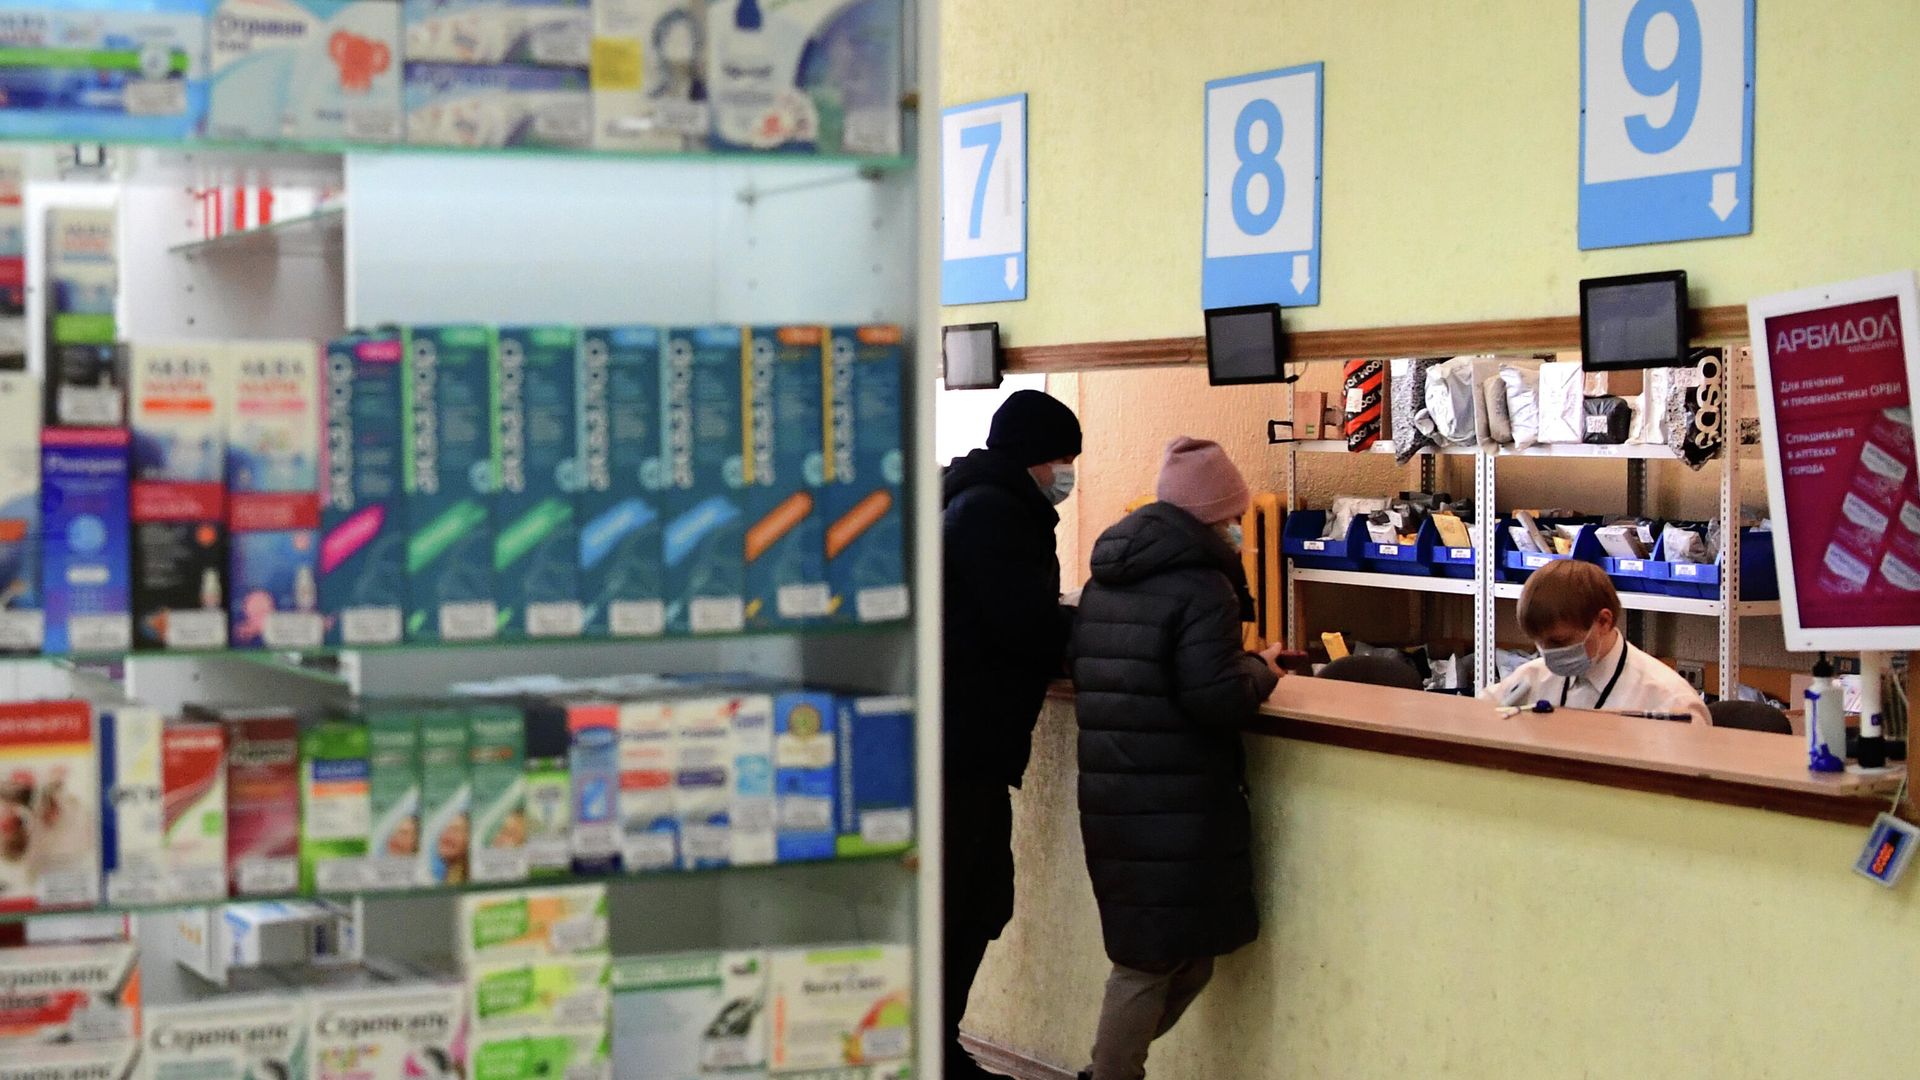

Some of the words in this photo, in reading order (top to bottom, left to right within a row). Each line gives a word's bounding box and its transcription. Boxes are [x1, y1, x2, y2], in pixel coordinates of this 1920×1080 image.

[1622, 0, 1702, 155] 9
[962, 123, 1001, 238] 7
[1232, 99, 1285, 236] 8
[1775, 314, 1896, 354] АРБИДОЛ
[1781, 379, 1800, 393] Для
[1803, 375, 1843, 389] лечения
[1791, 389, 1868, 406] профилактики
[1870, 383, 1901, 397] ОРВИ
[1785, 427, 1855, 445] Спрашивайте
[1796, 446, 1837, 459] аптеках
[1789, 464, 1825, 476] города
[150, 1023, 289, 1053] Стрепсилс
[317, 1012, 449, 1042] Стрепсилс
